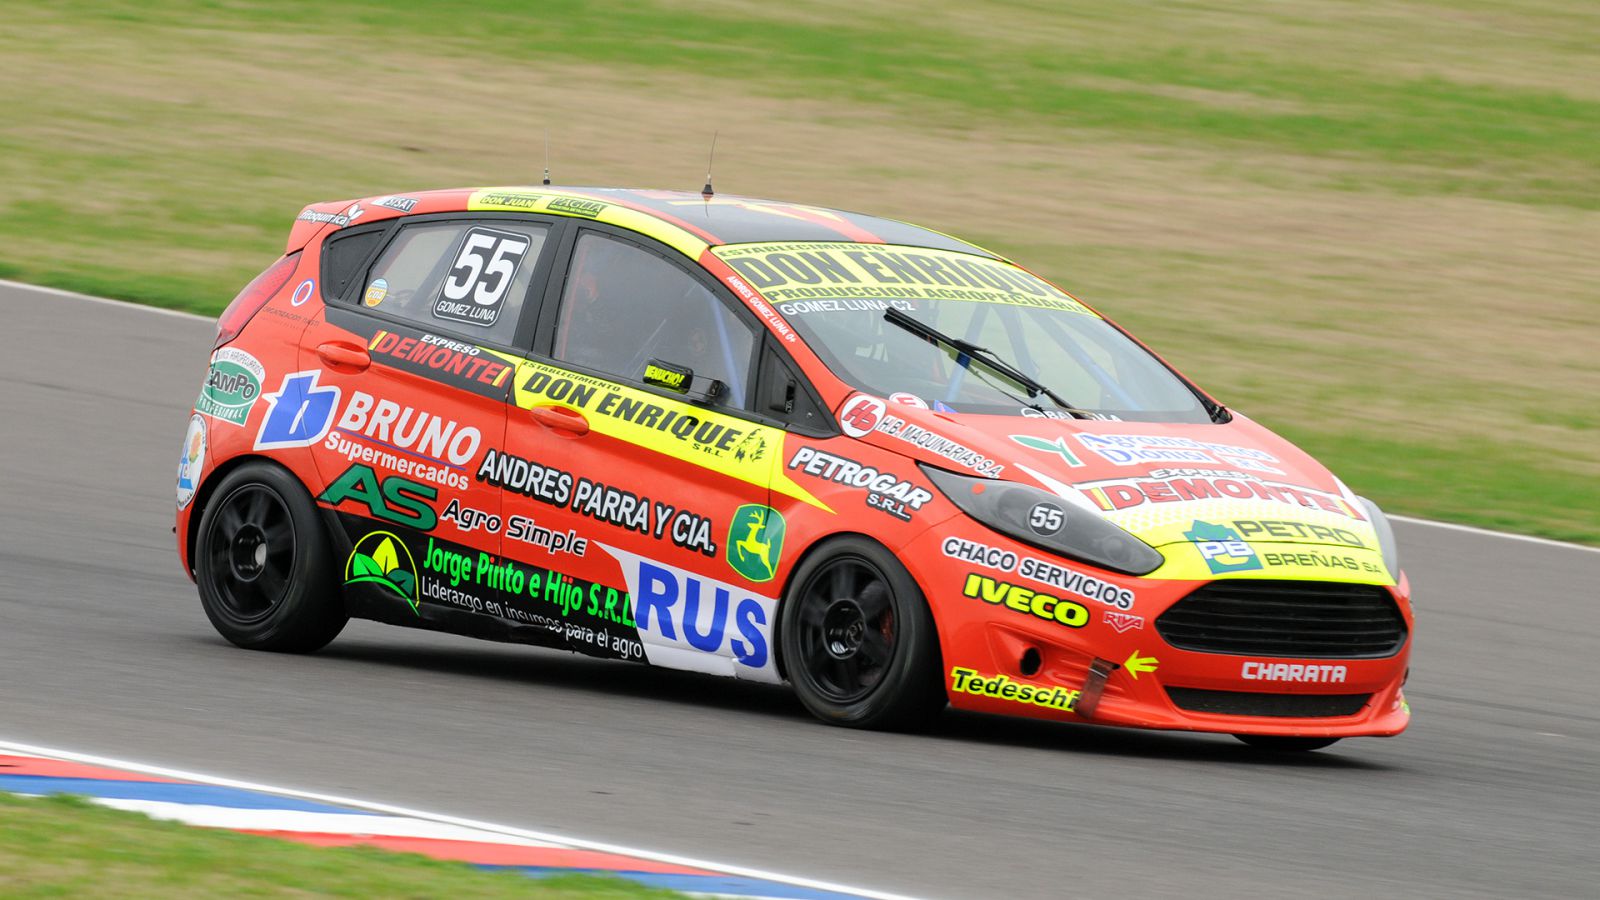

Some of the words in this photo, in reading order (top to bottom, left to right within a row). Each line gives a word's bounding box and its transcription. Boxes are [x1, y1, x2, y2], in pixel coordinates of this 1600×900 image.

[444, 233, 527, 306] 55
[718, 243, 886, 257] ESTABLECIMIENTO
[725, 252, 862, 289] DON
[437, 301, 471, 316] GOMEZ
[469, 307, 496, 321] LUNA
[726, 276, 753, 299] ANDRES
[749, 296, 774, 319] GOMEZ
[769, 316, 789, 336] LUNA
[763, 286, 923, 302] PRODUCCION
[780, 301, 843, 315] GOMEZ
[845, 300, 890, 311] LUNA
[891, 301, 916, 311] C2
[377, 332, 505, 384] DEMONTE
[421, 335, 480, 356] EXPRESO
[522, 361, 621, 392] ESTABLECIMIENTO
[337, 391, 481, 465] BRUNO
[521, 371, 598, 407] DON
[595, 392, 743, 452] ENRIQUE
[325, 431, 469, 490] Supermercados
[901, 425, 981, 467] MAQUINARIAS
[1097, 448, 1213, 464] Dionisi
[319, 464, 438, 531] AS
[789, 447, 932, 510] PETROGAR
[1100, 478, 1348, 516] DEMONTE
[478, 450, 572, 503] ANDRES
[573, 480, 648, 531] PARRA
[656, 506, 673, 536] Y
[673, 513, 715, 552] CIA.
[867, 494, 911, 521] S.R.L.
[1030, 506, 1063, 531] 55
[441, 500, 501, 533] Agro
[506, 516, 588, 557] Simple
[1232, 521, 1365, 548] PETRO
[1196, 541, 1256, 560] PB
[1264, 550, 1359, 571] BREÑAS
[423, 537, 472, 587] Jorge
[476, 556, 524, 594] Pinto
[529, 575, 541, 598] e
[544, 573, 583, 617] Hijo
[944, 538, 1015, 571] CHACO
[1020, 559, 1132, 610] SERVICIOS
[422, 576, 483, 613] Liderazgo
[486, 601, 504, 619] en
[565, 622, 594, 643] para
[597, 628, 609, 648] el
[612, 636, 643, 659] agro
[635, 561, 768, 668] RUS
[964, 573, 1089, 627] IVECO
[953, 669, 1080, 710] Tedeschi
[1241, 662, 1347, 682] CHARATA
